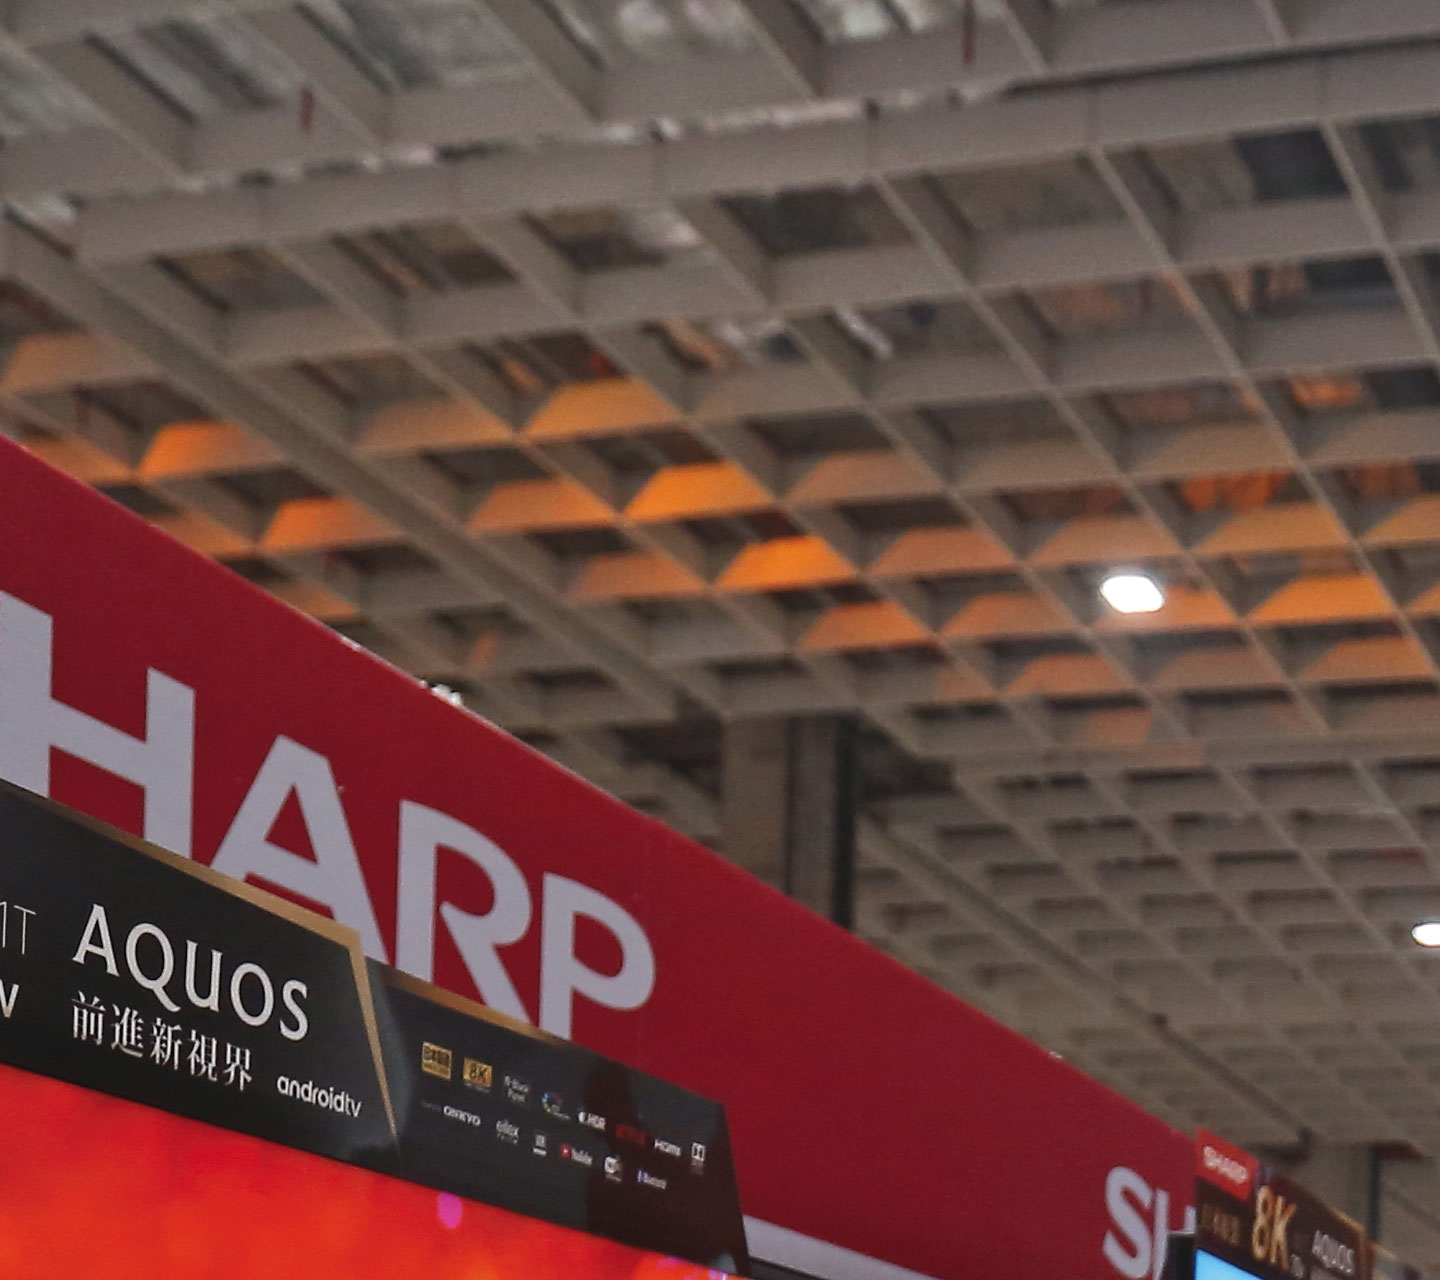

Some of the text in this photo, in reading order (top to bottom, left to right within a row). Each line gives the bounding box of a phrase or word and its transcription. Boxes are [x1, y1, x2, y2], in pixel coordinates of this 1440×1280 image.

[72, 903, 310, 1041] AQUOS
[70, 990, 253, 1092] 前進新視界
